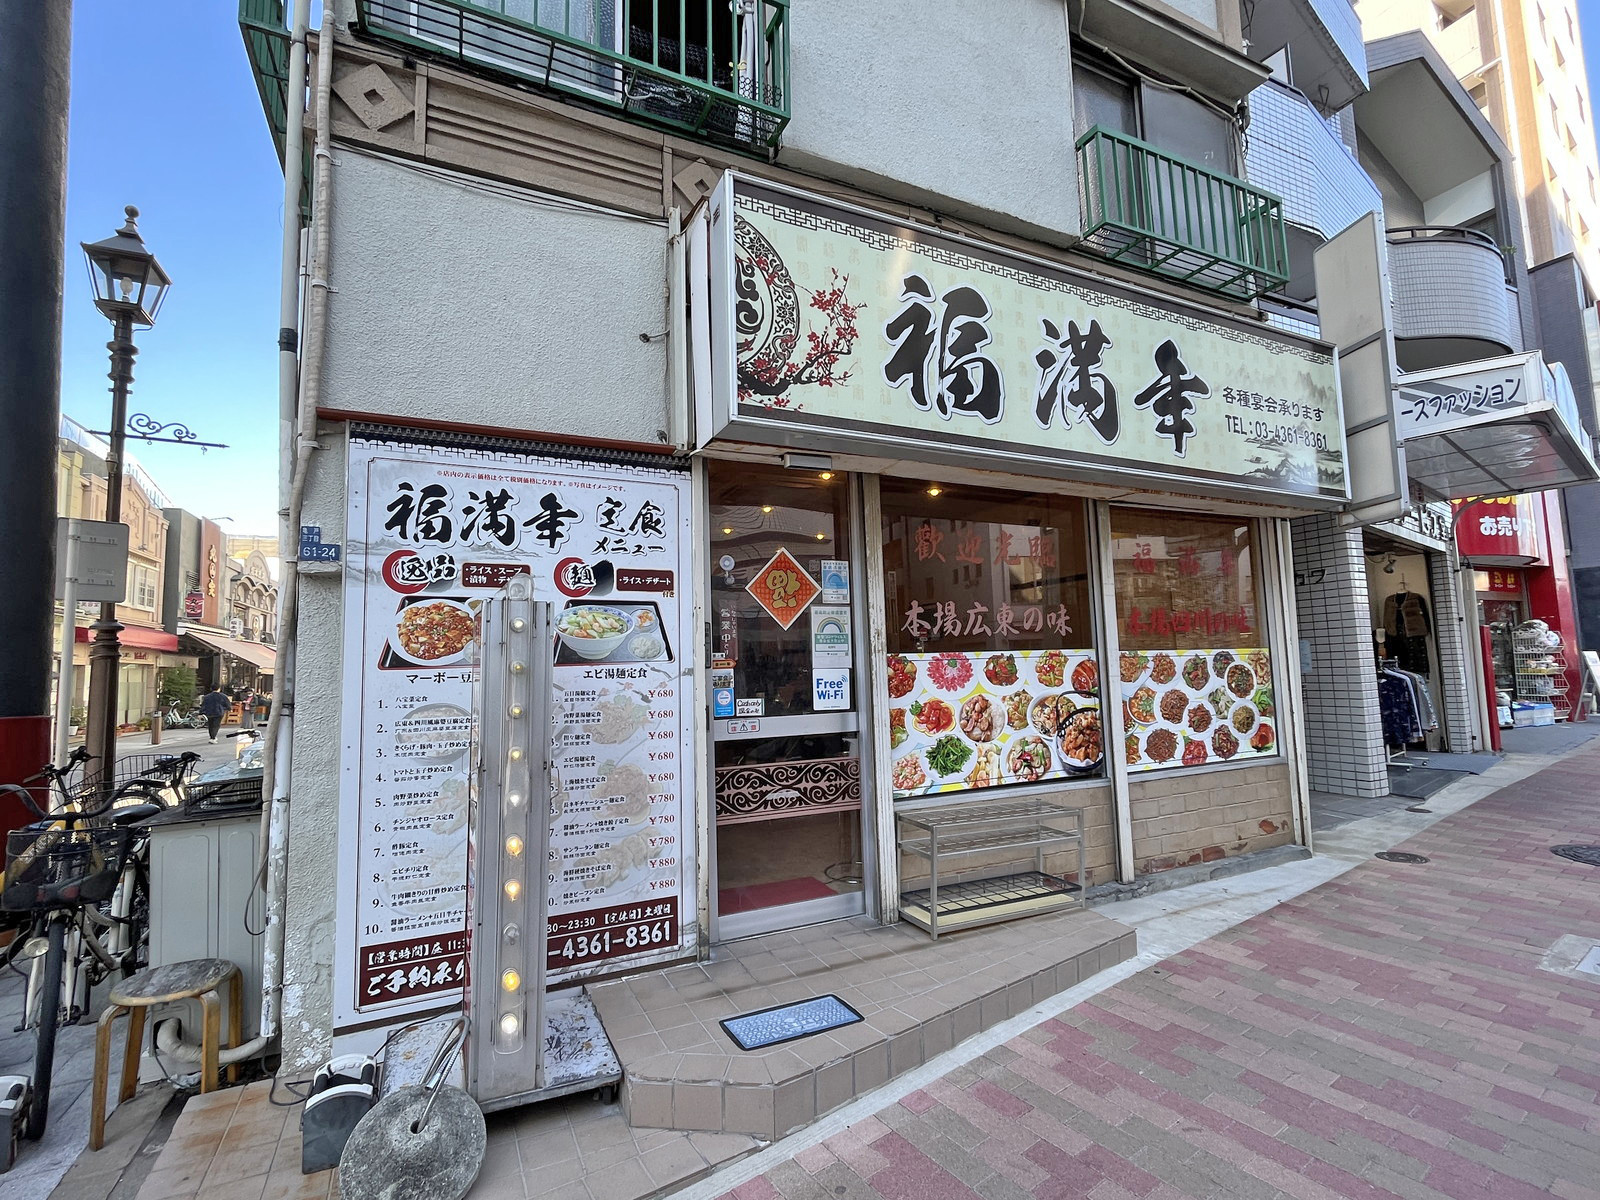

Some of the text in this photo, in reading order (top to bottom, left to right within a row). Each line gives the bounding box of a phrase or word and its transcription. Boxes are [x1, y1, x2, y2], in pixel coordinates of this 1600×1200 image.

[1222, 386, 1324, 421] 各種宴会承ります
[599, 496, 665, 535] 定食
[594, 536, 664, 555] メニュー
[303, 546, 335, 557] 61-24
[901, 600, 1073, 637] 本場広東の味
[583, 667, 648, 679] エビ湯麺定食
[816, 678, 843, 689] Free
[816, 690, 844, 700] Wi-Fi
[377, 700, 388, 709] 1.
[376, 724, 388, 733] 2.
[376, 748, 387, 758] 3.
[375, 773, 387, 782] 4.
[374, 798, 386, 807] 5.
[374, 823, 386, 832] 6.
[549, 828, 558, 837] 7.
[373, 848, 385, 857] 7.
[548, 851, 558, 860] 8.
[372, 873, 384, 883] 8.
[548, 874, 558, 883] 9.
[372, 898, 384, 908] 9.
[365, 924, 383, 935] 10.
